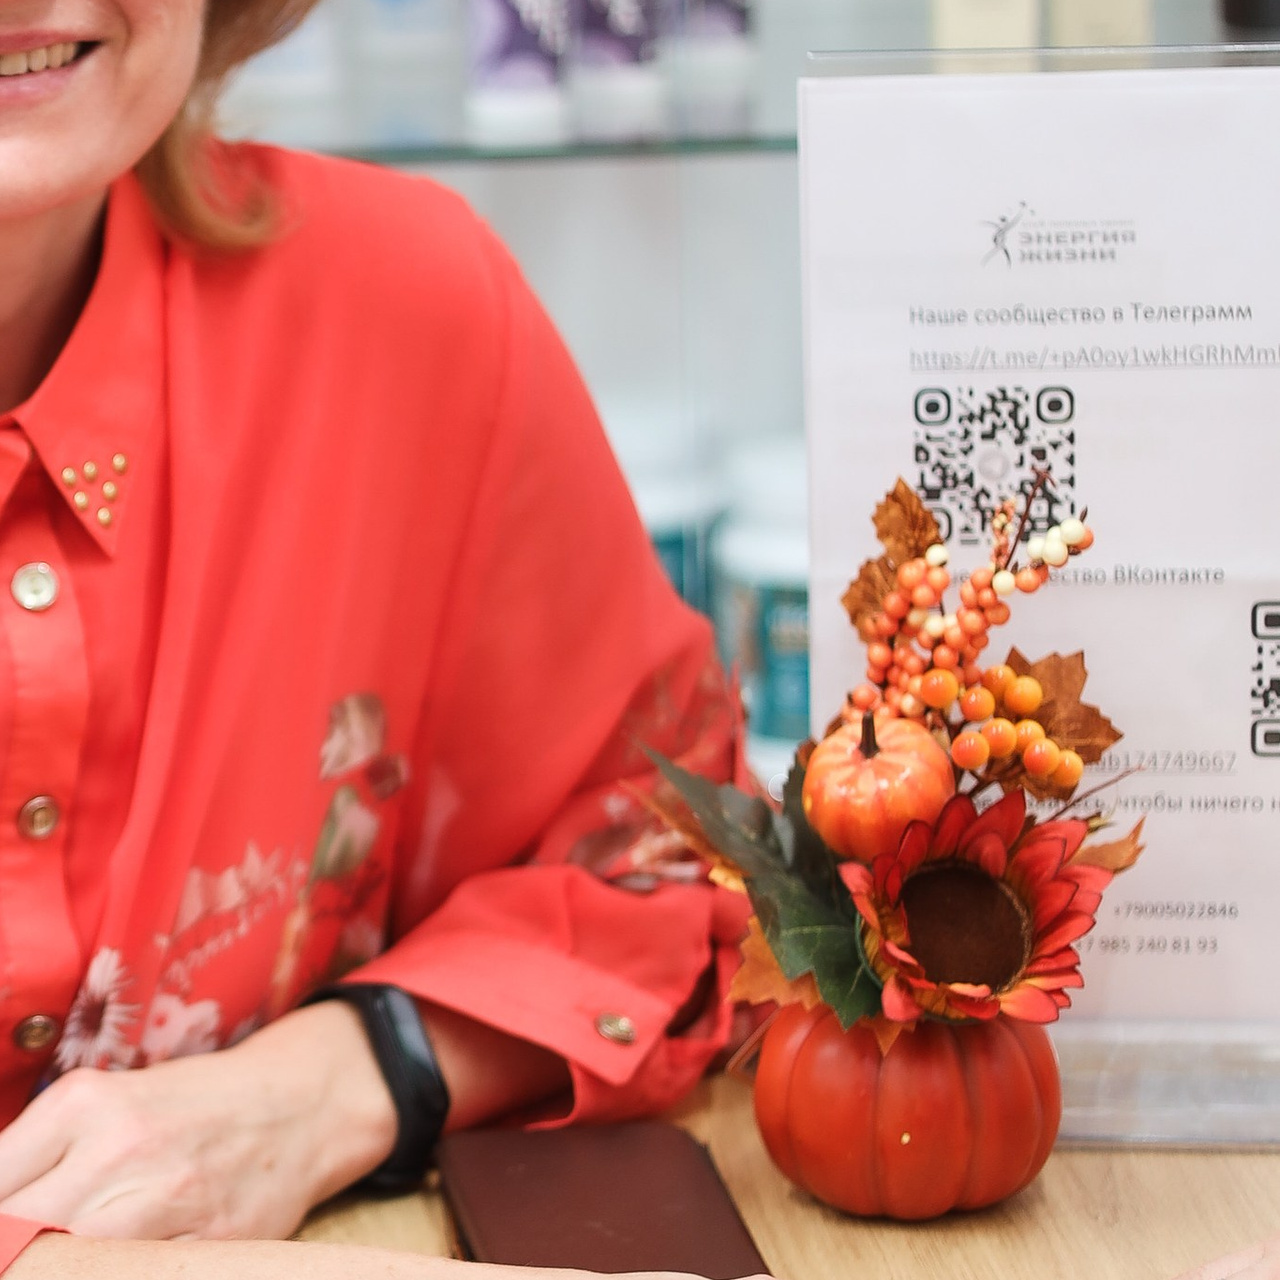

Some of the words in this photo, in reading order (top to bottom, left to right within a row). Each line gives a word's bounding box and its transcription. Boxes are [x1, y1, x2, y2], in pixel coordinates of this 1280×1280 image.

[1018, 230, 1136, 245] ЭНЕРГИЯ
[1019, 248, 1117, 263] ЖИЗНИ
[909, 305, 968, 325] Наше
[973, 303, 1106, 326] сообщество
[1113, 307, 1124, 321] в
[1130, 302, 1253, 326] Телеграмм
[1114, 564, 1225, 586] ВКонтакте
[1120, 790, 1183, 812] чтобы
[1190, 795, 1264, 812] ничего
